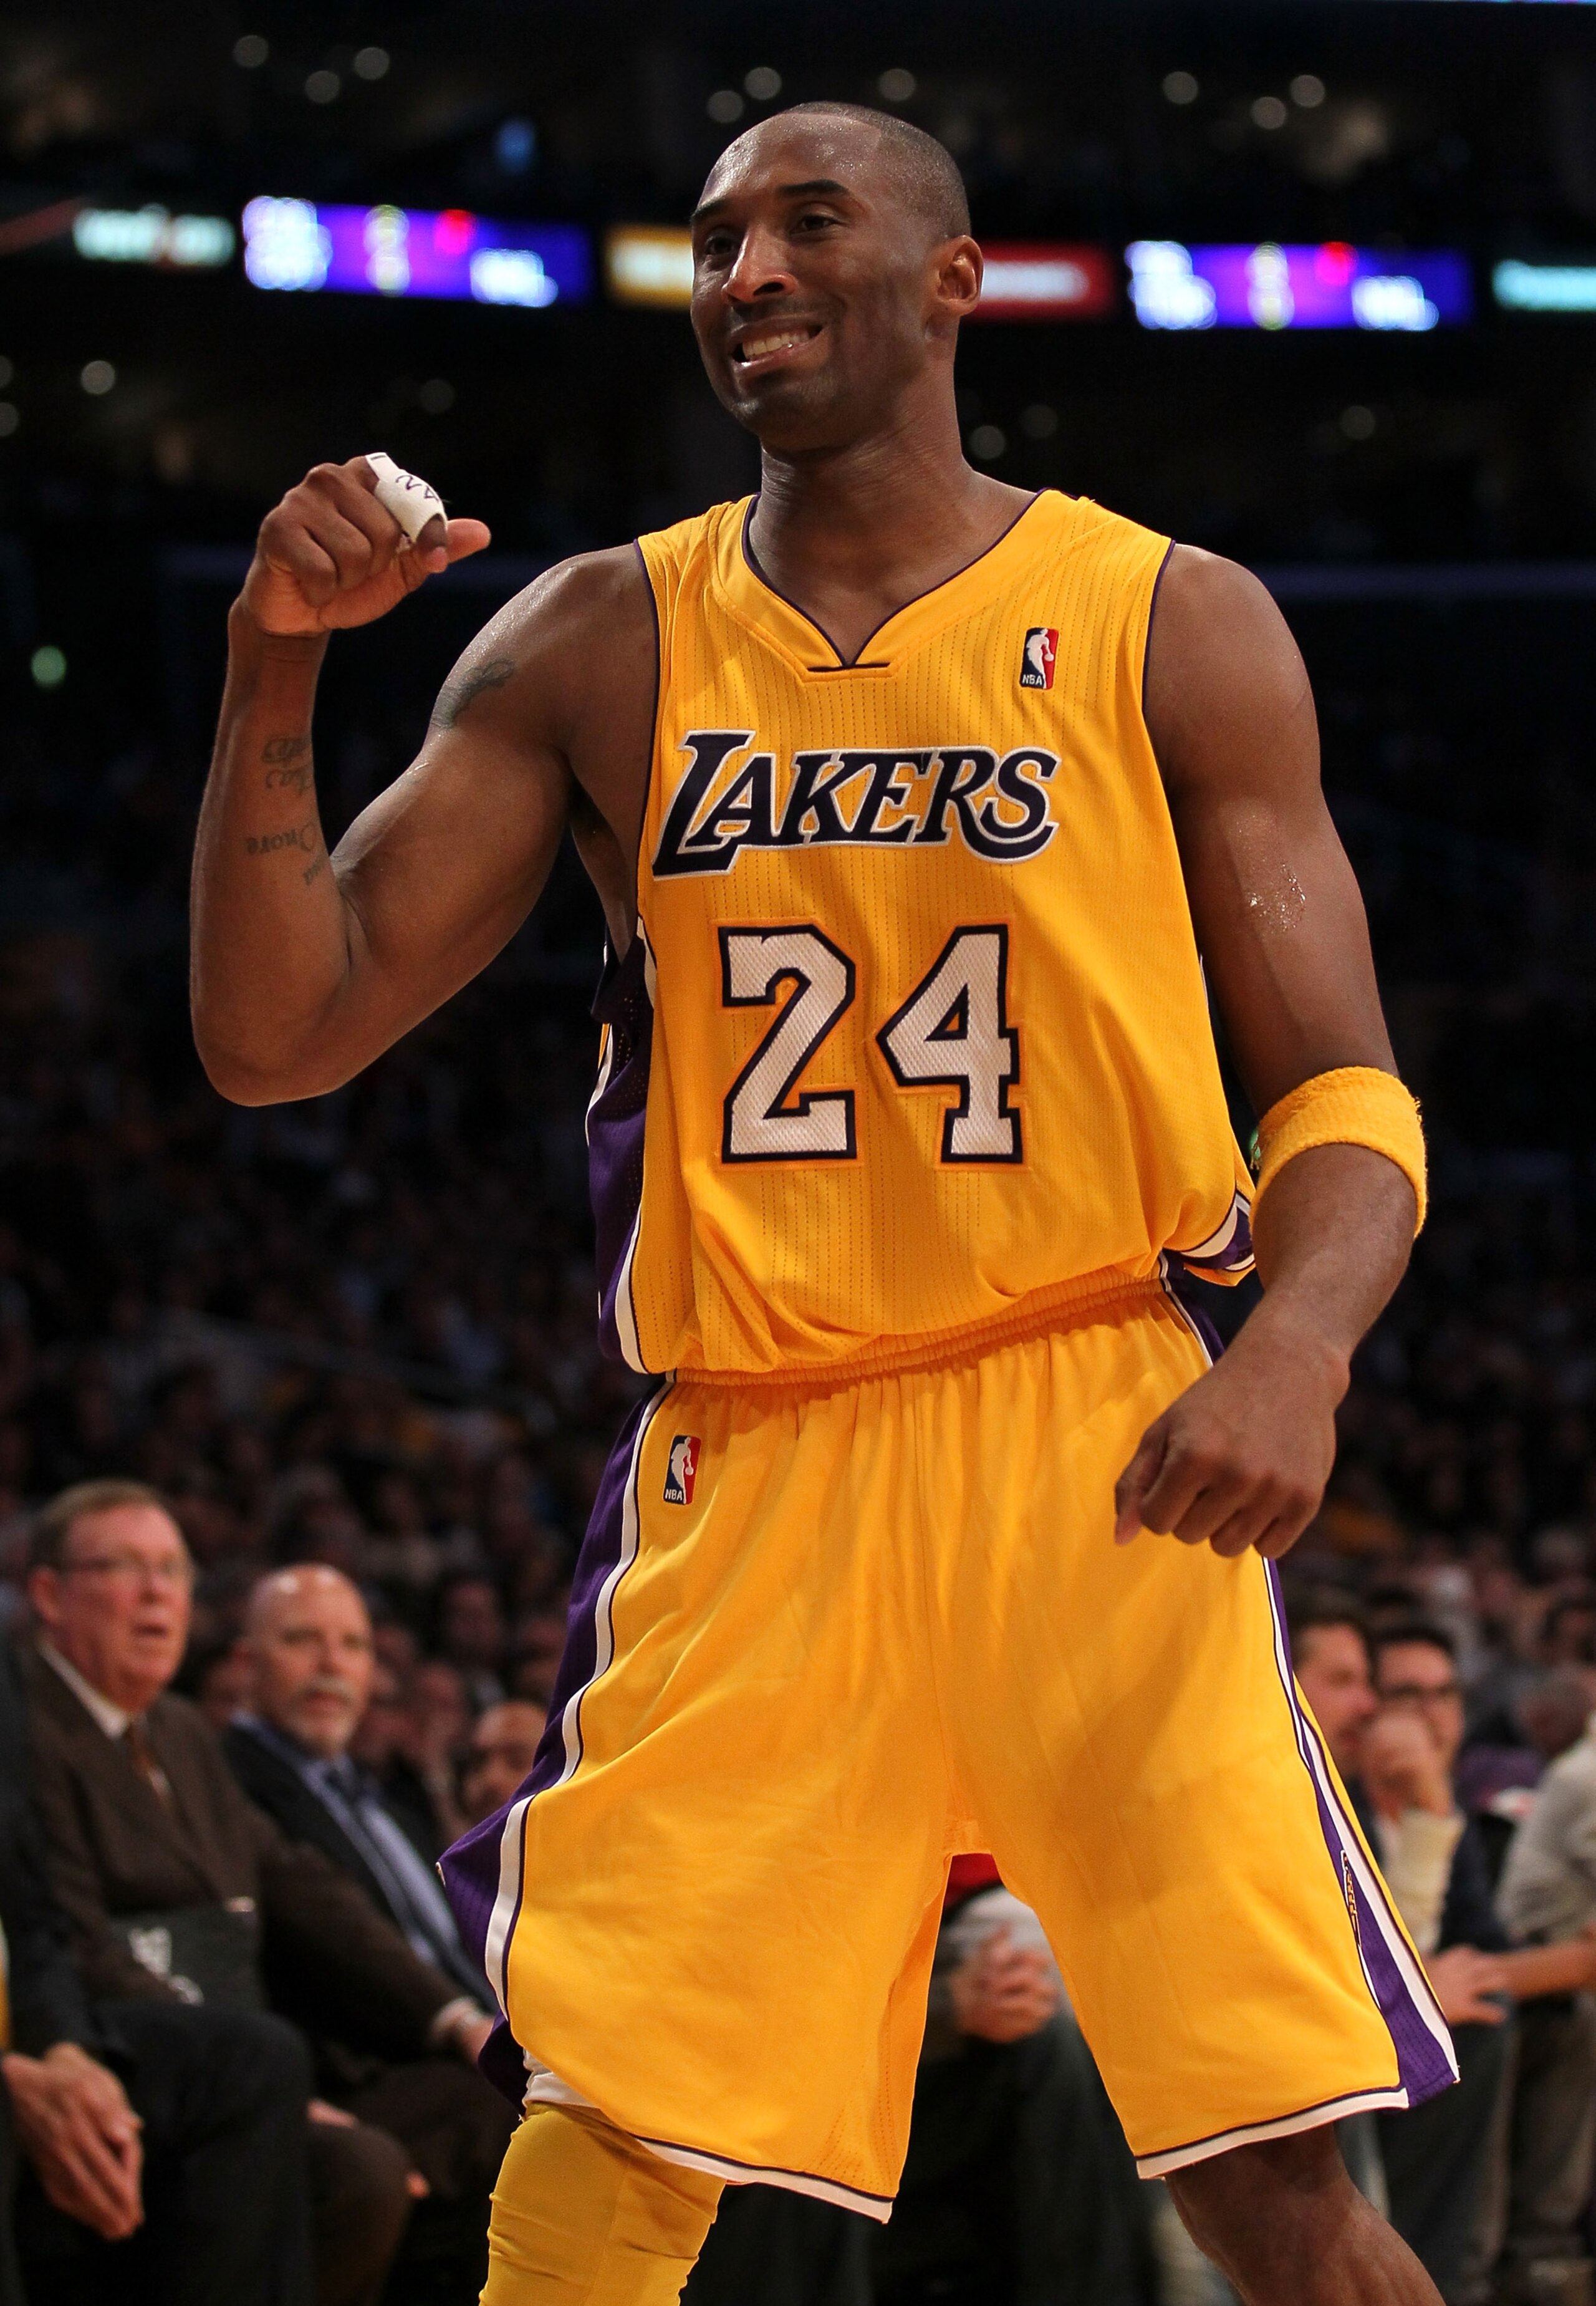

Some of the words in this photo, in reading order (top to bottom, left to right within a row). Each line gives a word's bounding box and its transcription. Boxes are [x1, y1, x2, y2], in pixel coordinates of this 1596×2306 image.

[1022, 674, 1042, 685] NBA
[651, 729, 1062, 881] LAKERS
[718, 923, 1024, 1164] 24
[665, 1488, 683, 1501] NBA
